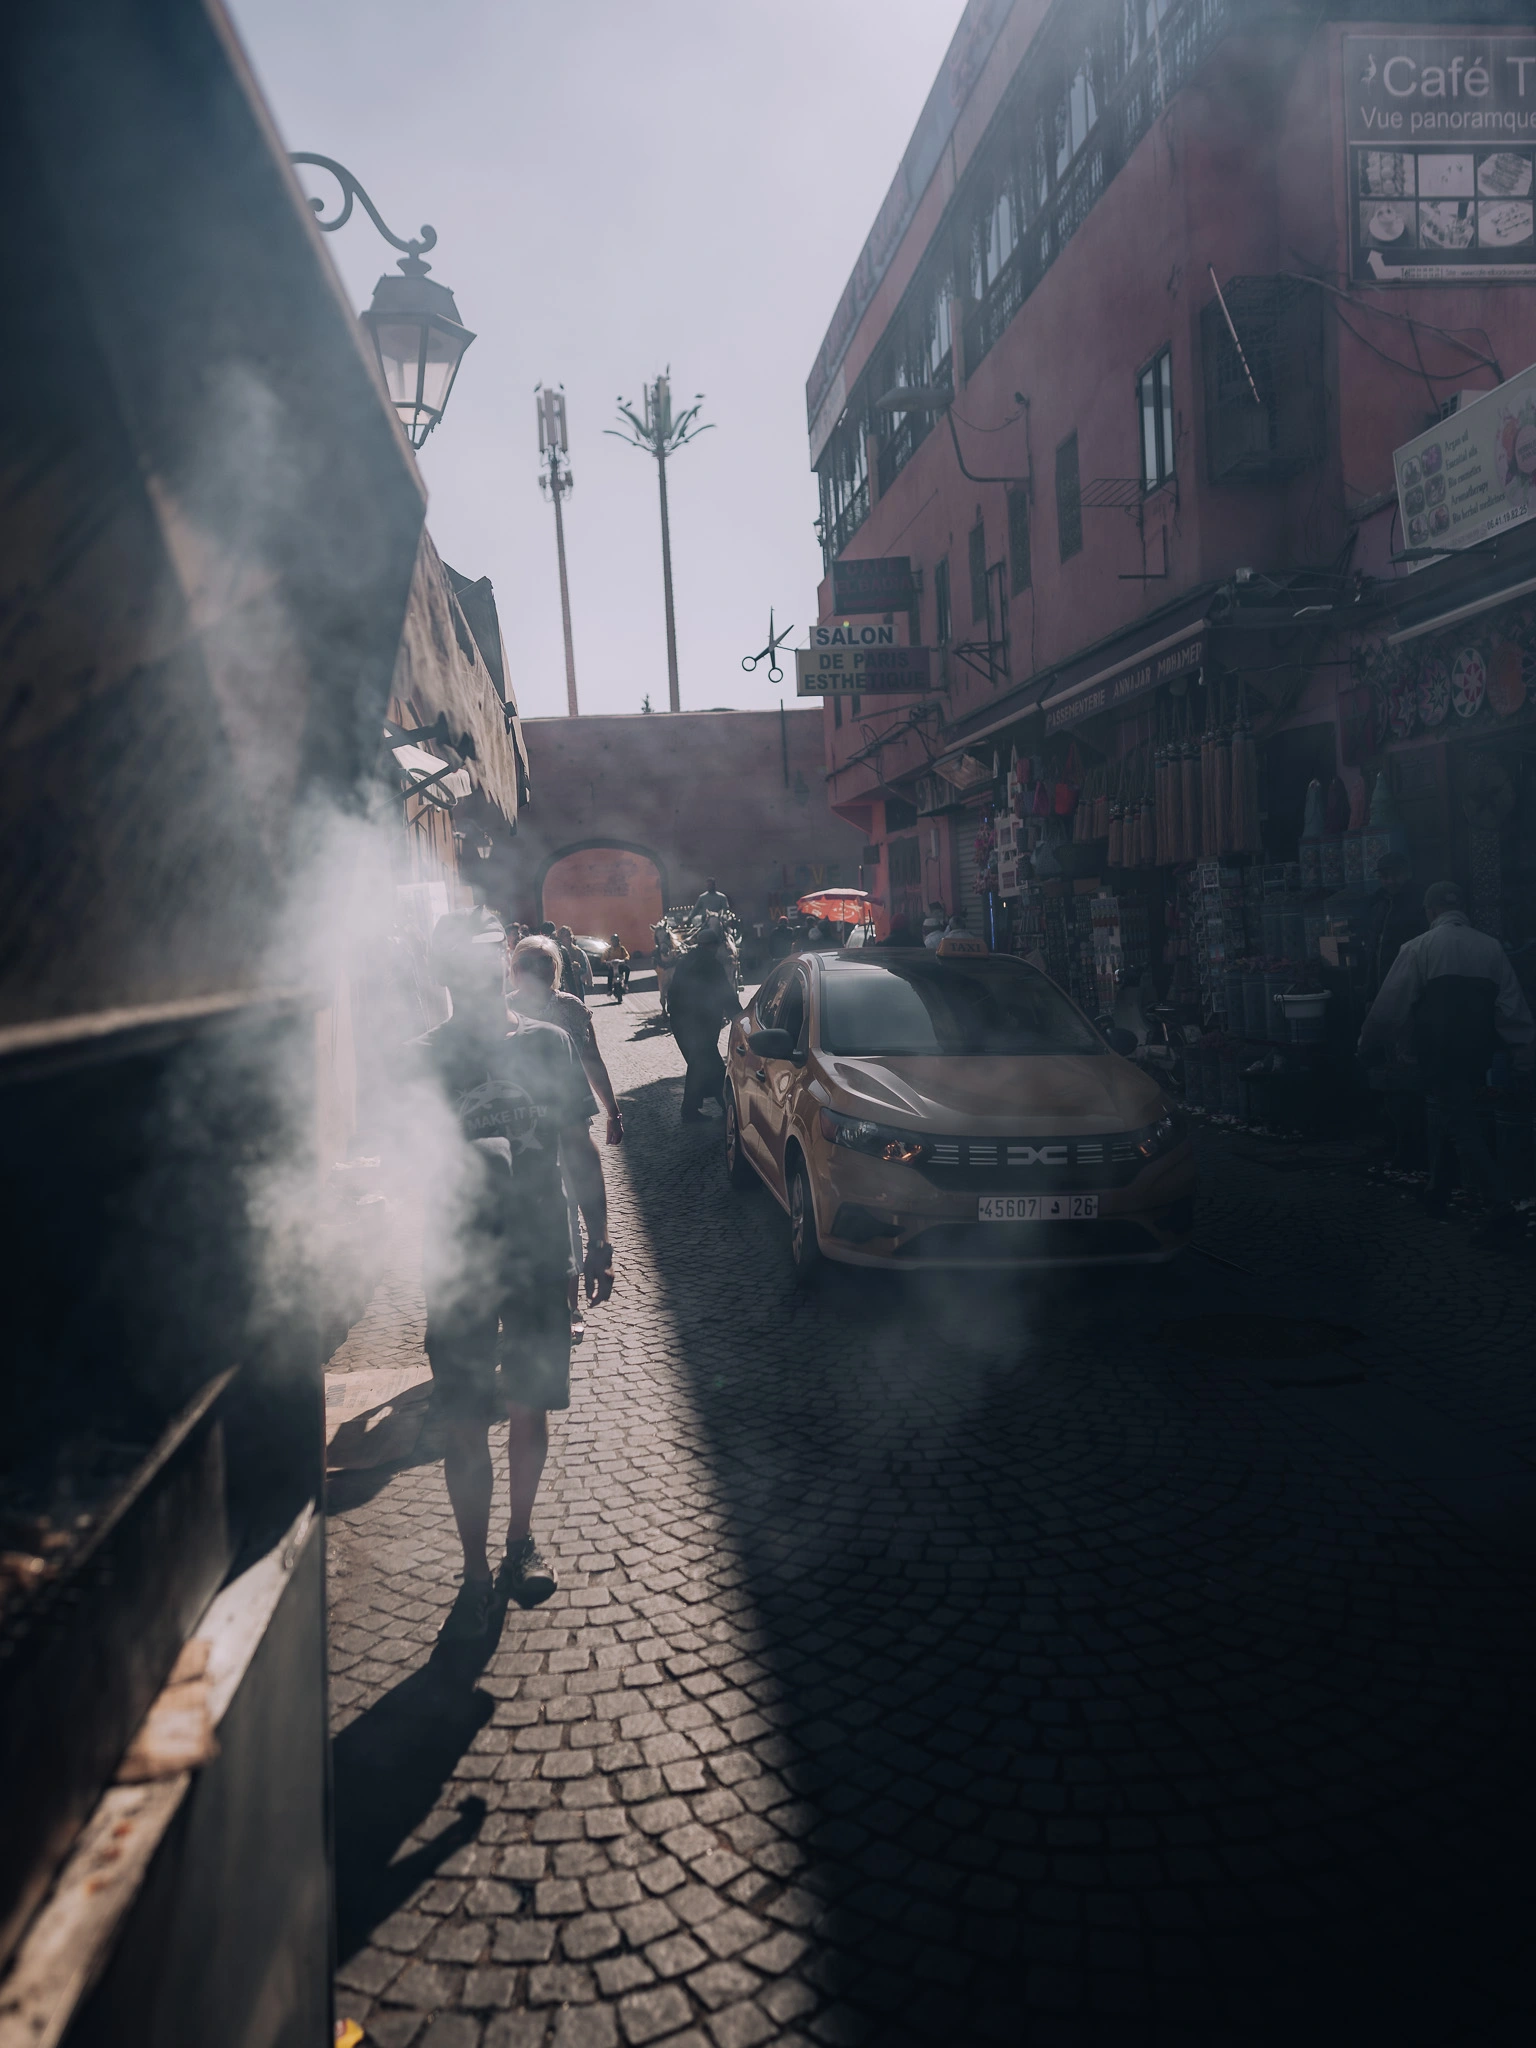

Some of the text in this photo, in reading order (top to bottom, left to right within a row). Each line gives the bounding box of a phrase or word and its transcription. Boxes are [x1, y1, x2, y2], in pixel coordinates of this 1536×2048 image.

[1383, 56, 1490, 97] Café
[1361, 106, 1404, 129] Vue
[815, 626, 894, 646] SALON
[819, 652, 909, 670] DE PARIS
[804, 671, 925, 690] ESTHETIQUE
[1046, 642, 1202, 728] PASSEMENTERIE ANNAJAR MOHAMED
[782, 863, 841, 888] LOVE
[950, 942, 981, 953] TAXI
[468, 1105, 549, 1131] MAKE IT FLY
[984, 1199, 1037, 1218] 45607
[1073, 1198, 1093, 1216] 26
